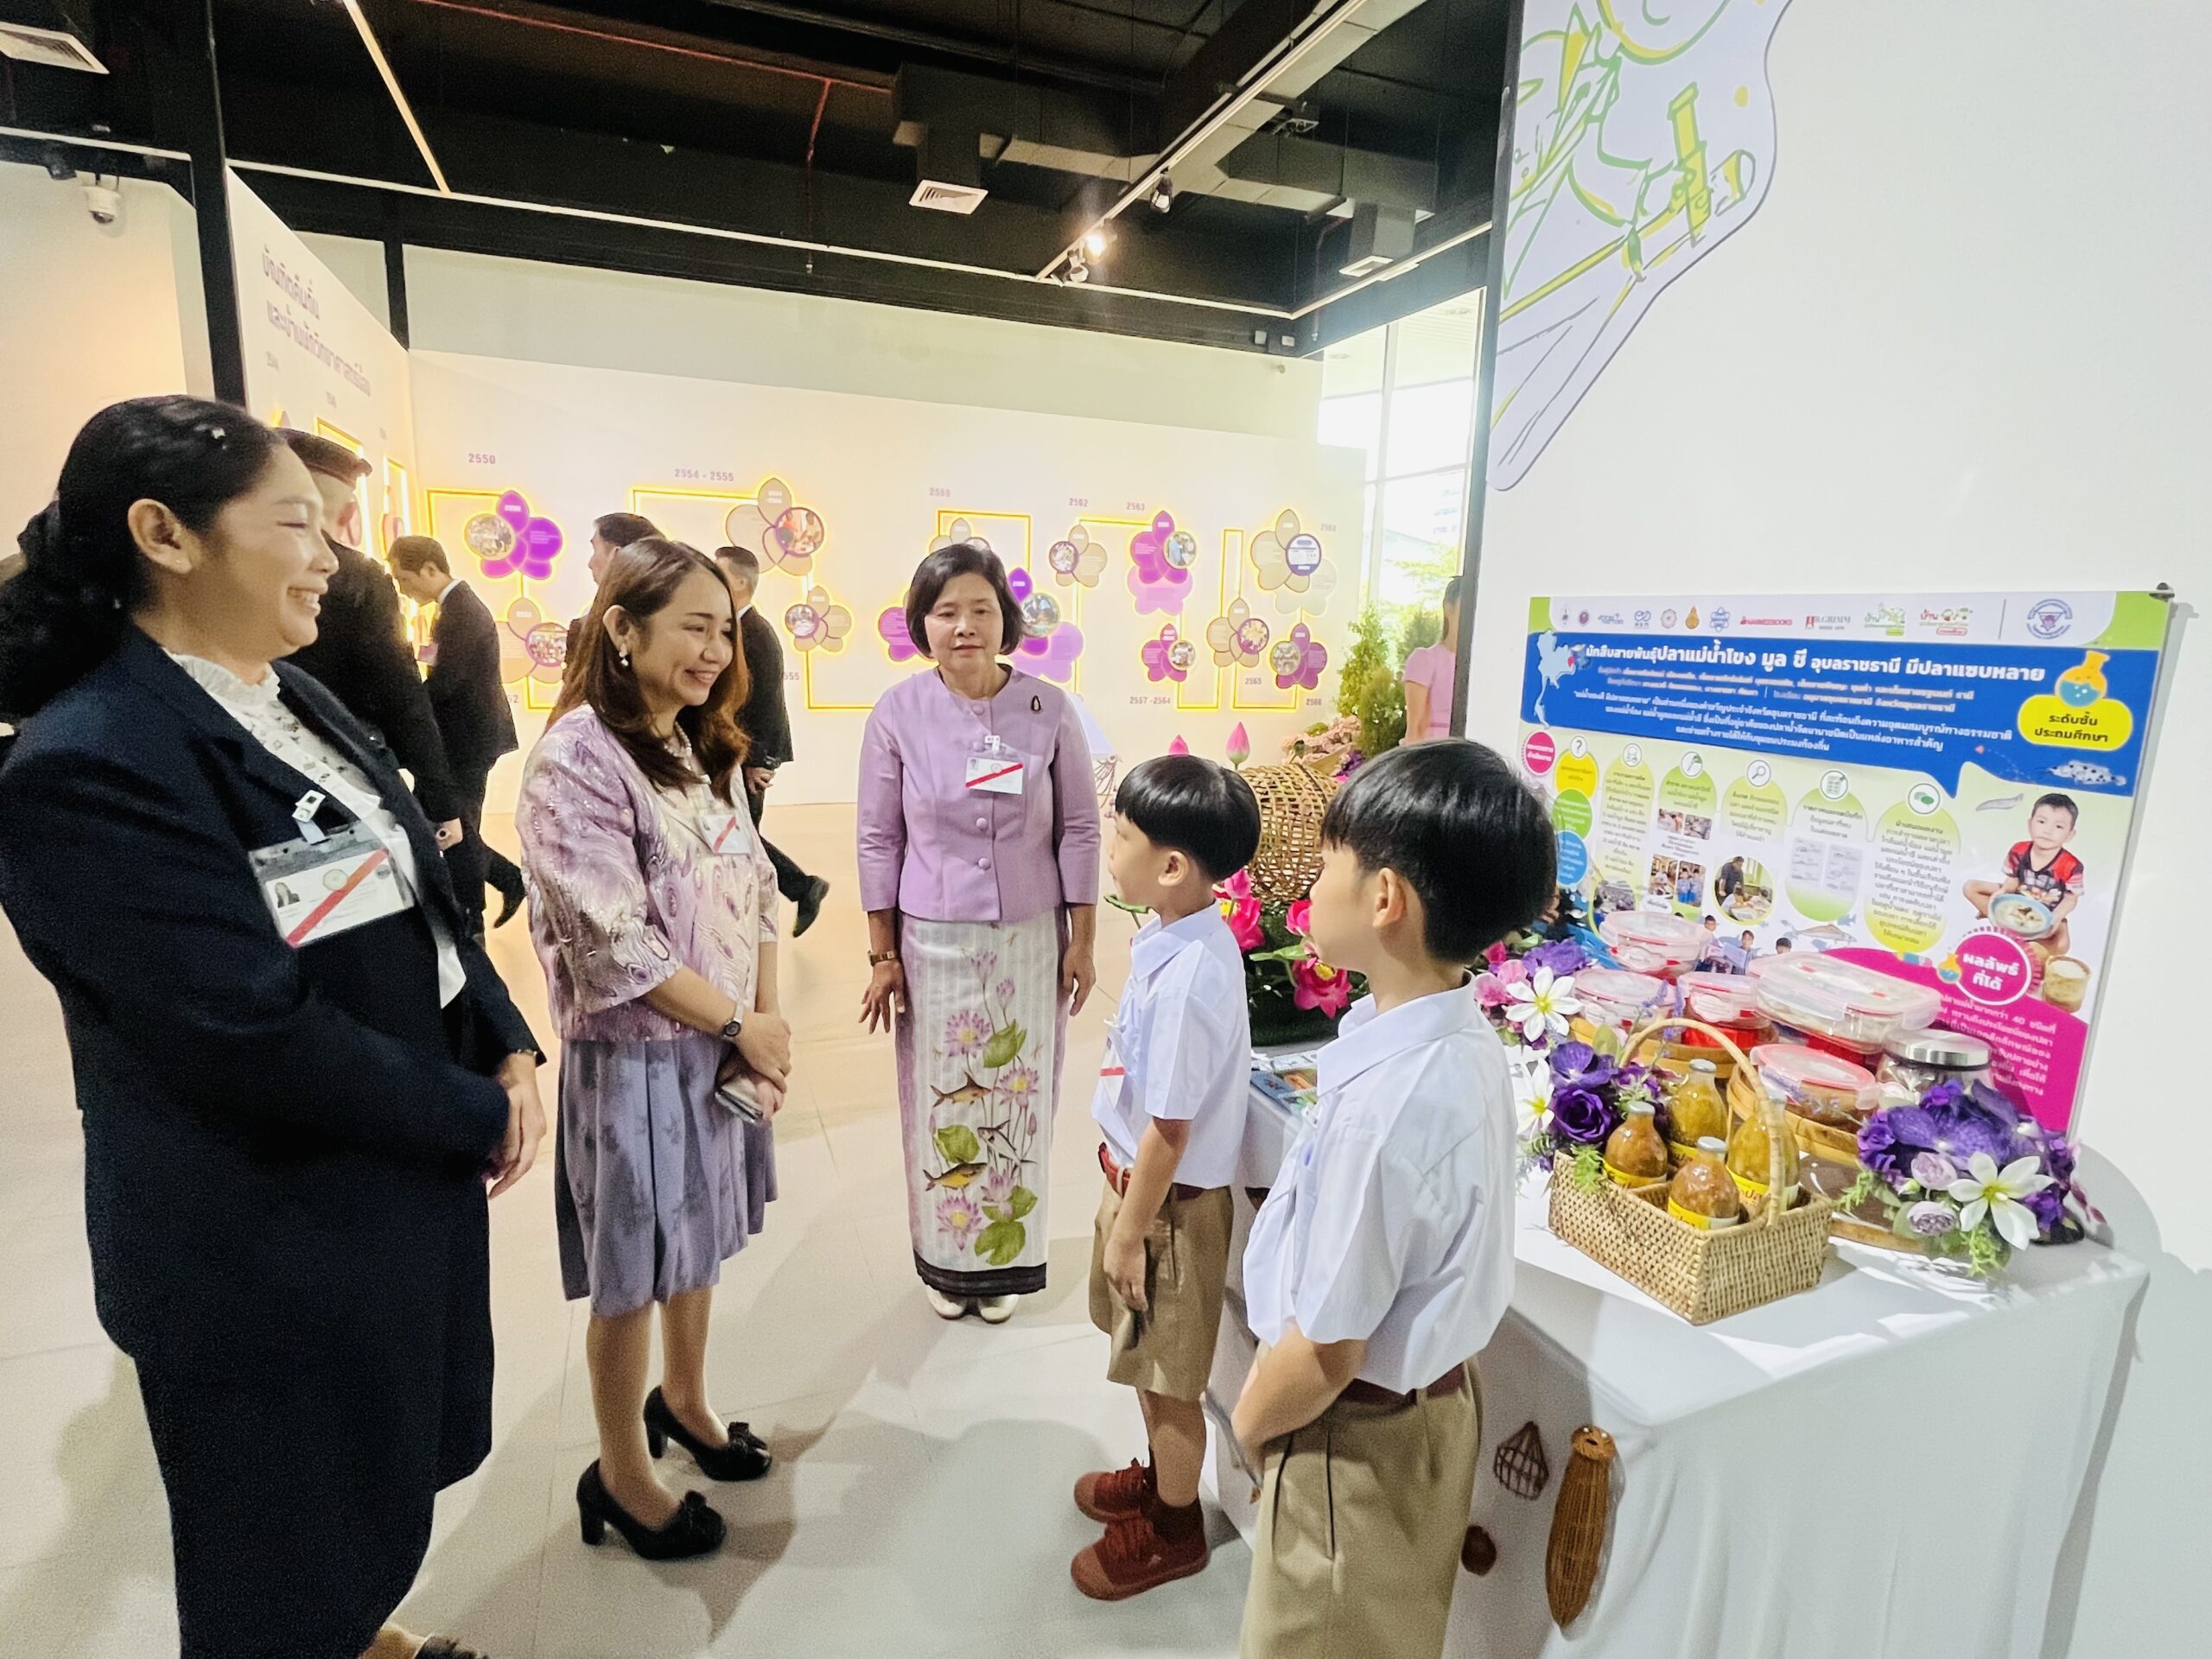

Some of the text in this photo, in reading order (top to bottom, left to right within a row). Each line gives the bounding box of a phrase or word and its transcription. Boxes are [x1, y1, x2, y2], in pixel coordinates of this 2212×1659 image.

[468, 453, 496, 465] 2550
[674, 468, 699, 479] 2554
[710, 470, 734, 481] 2555
[1760, 652, 1788, 671] มูล
[1793, 649, 1808, 669] ชี
[1810, 657, 1902, 675] อุบลราชธานี
[1905, 658, 2046, 682] มีปลาแซบหลาย
[2049, 711, 2099, 727] ระดับชั้น
[2034, 728, 2108, 743] ประถมศึกษา
[1962, 953, 2020, 977] ผลลัพธ์
[1972, 969, 2004, 992] ที่ได้
[1942, 995, 2009, 1020] ปลาแม่น้ำมากกว่า
[2012, 1014, 2026, 1026] 40
